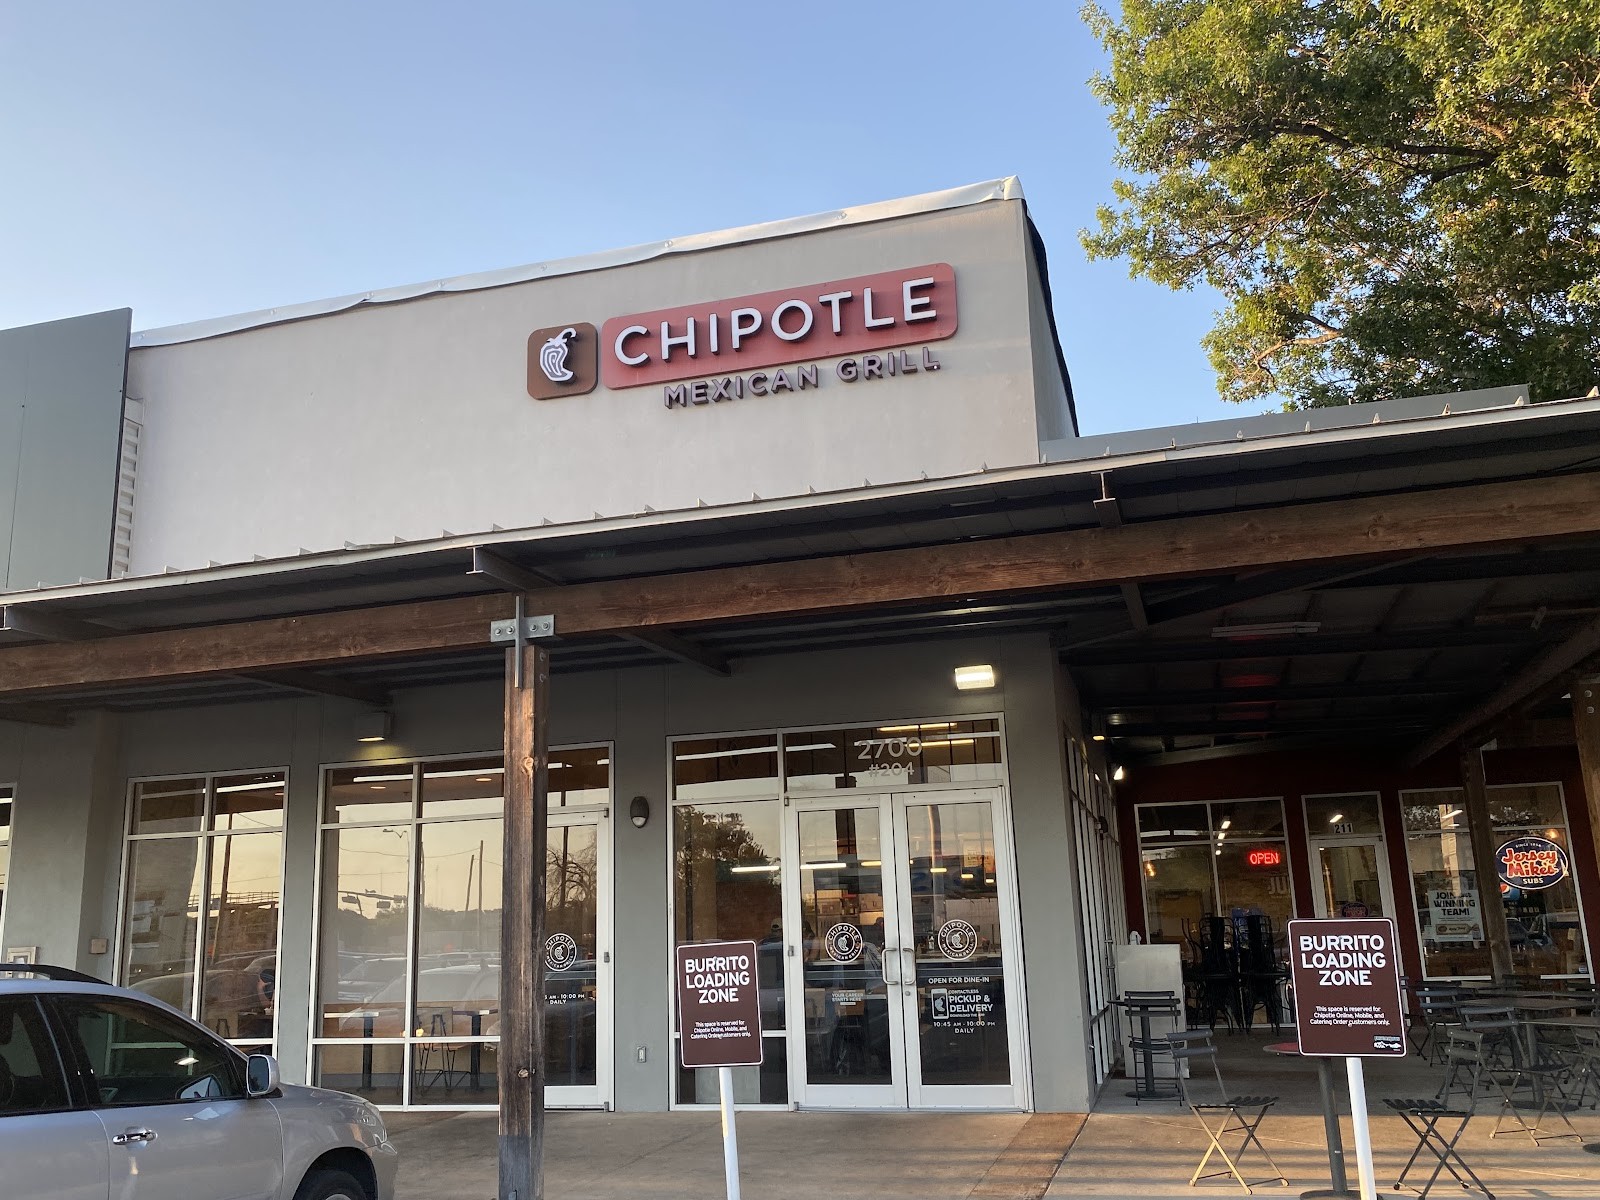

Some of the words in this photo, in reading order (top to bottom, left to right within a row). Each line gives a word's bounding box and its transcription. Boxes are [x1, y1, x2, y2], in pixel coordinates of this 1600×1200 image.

[614, 277, 937, 367] CHIPOTLE
[664, 363, 819, 409] MEXICAN
[836, 346, 941, 383] GRILL
[858, 737, 922, 760] 2700
[868, 762, 914, 777] #204
[1335, 823, 1352, 834] 211
[1250, 852, 1280, 865] OPEN
[1501, 848, 1558, 864] Jersey
[1523, 877, 1544, 885] SUBS
[1433, 899, 1476, 908] WINNING
[1441, 908, 1470, 916] TEAM!
[828, 925, 860, 941] CHIPOTLE
[941, 922, 974, 938] CHIPOTLE
[546, 935, 575, 950] CHIPOTLE
[1300, 935, 1385, 951] BURRITO
[685, 955, 749, 973] BURRITO
[1301, 952, 1386, 969] LOADING
[686, 971, 750, 989] LOADING
[1319, 970, 1373, 986] ZONE
[698, 988, 739, 1004] ZONE
[949, 994, 982, 1003] PICKUP
[983, 994, 991, 1002] &
[950, 1003, 993, 1013] DELIVERY
